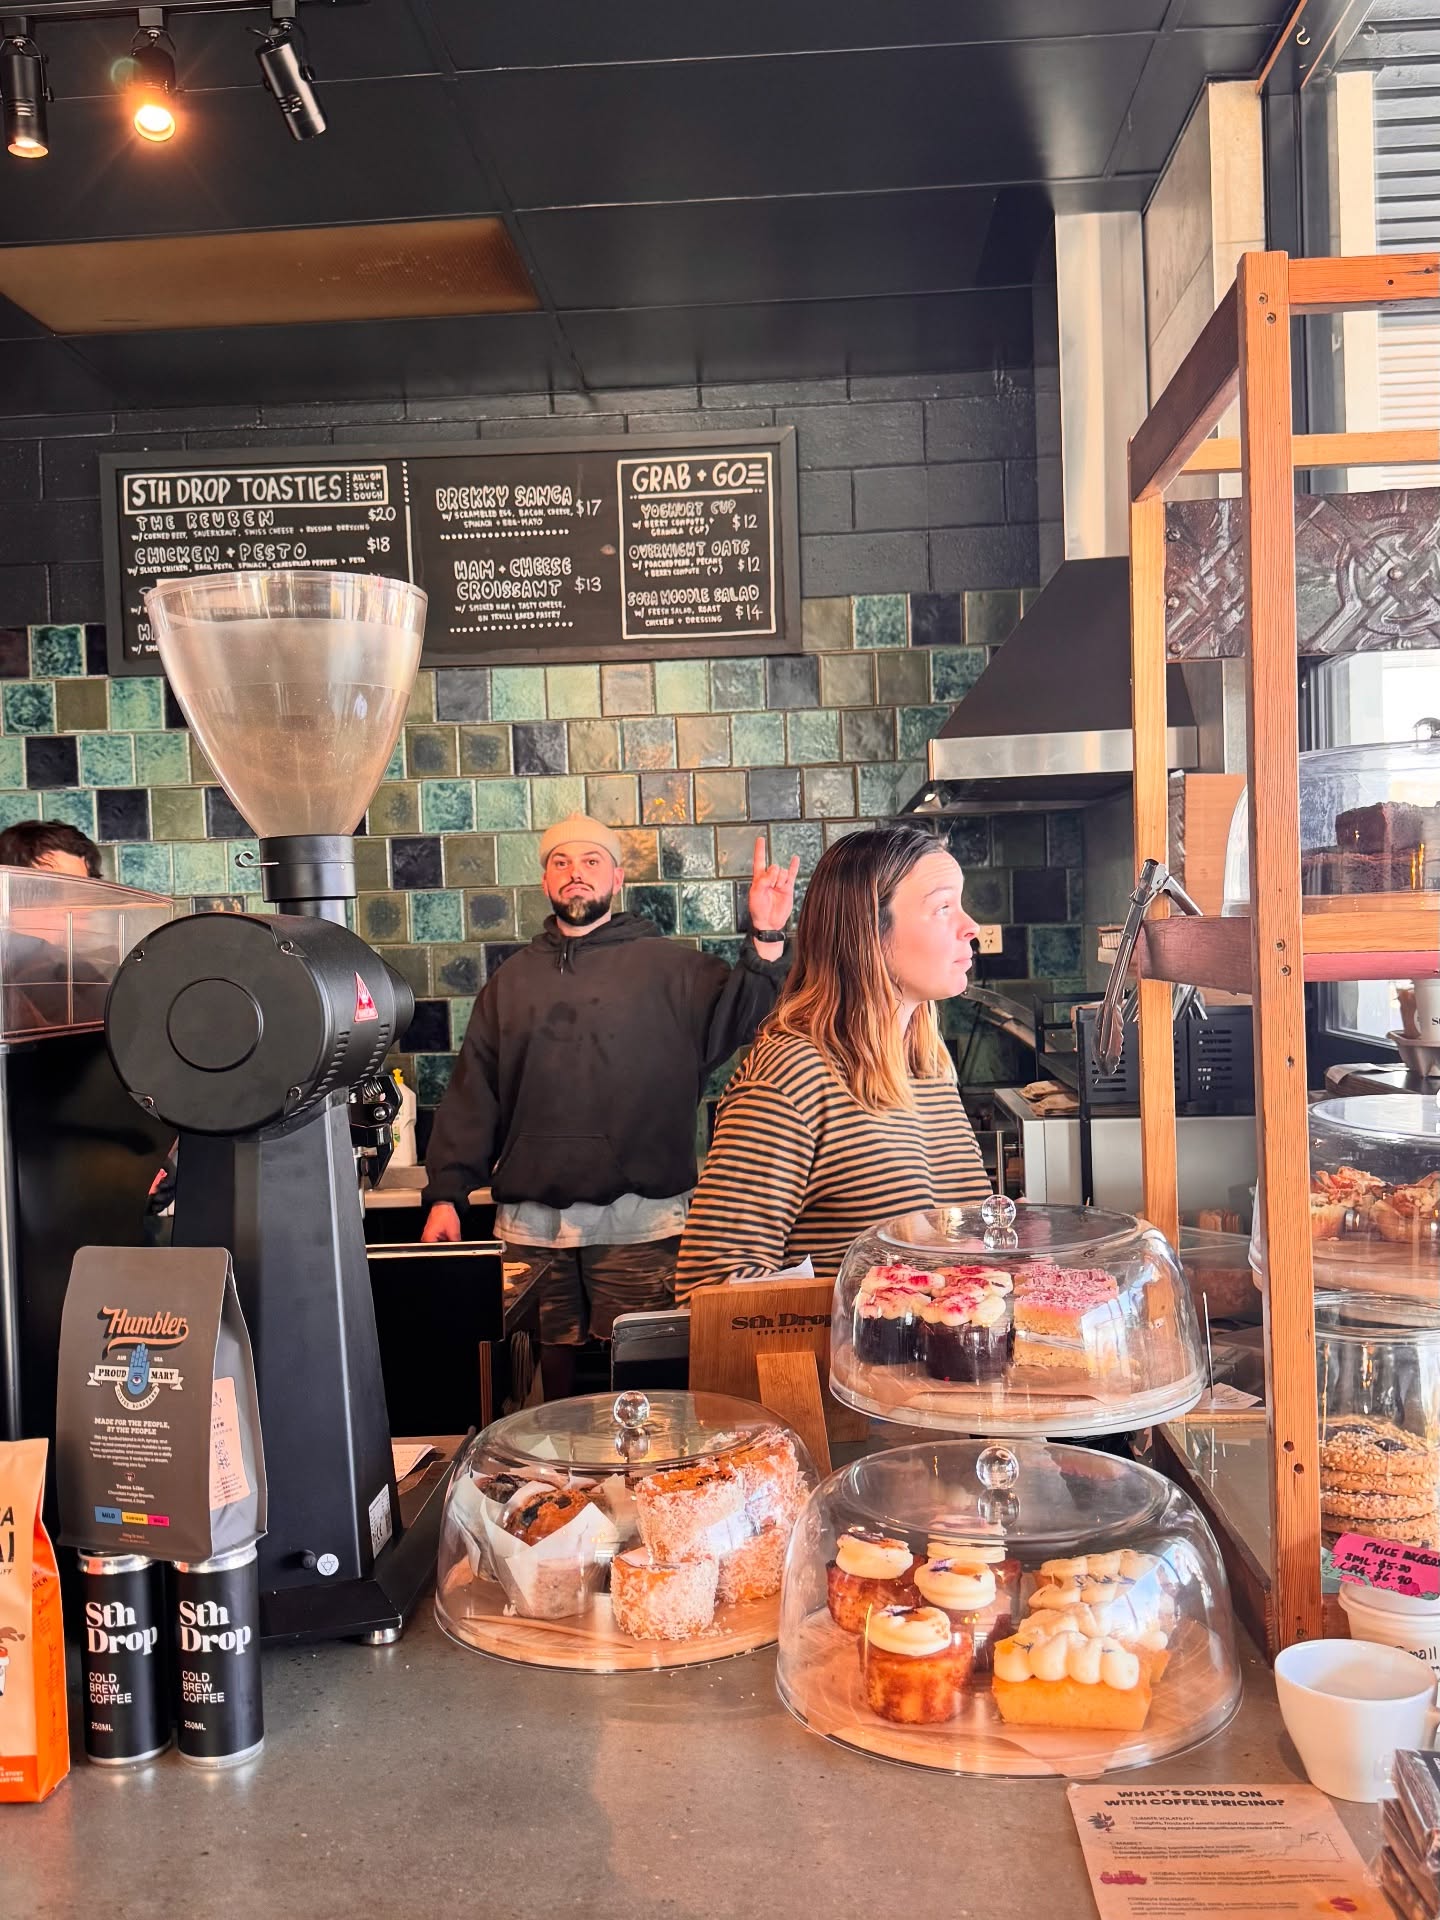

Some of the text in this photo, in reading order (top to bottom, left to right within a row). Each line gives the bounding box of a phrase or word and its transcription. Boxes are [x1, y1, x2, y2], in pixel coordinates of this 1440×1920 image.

[632, 462, 691, 493] GRAB
[132, 474, 342, 507] STH DROP TOASTIES
[353, 490, 383, 501] DOUGH
[436, 485, 573, 511] BREKKY SANGA
[368, 506, 396, 522] $20
[454, 509, 497, 520] SCRAMBLED
[575, 499, 602, 518] $17
[640, 499, 737, 520] YOGHURT CUP
[136, 509, 274, 531] THE REUBEN
[643, 518, 669, 529] BERRY
[732, 514, 758, 532] $12
[143, 532, 171, 541] CORNED
[244, 528, 267, 536] SWISS
[268, 526, 294, 535] CHEESE
[306, 525, 333, 533] RUSSIAN
[336, 523, 371, 532] DRESSING
[650, 527, 684, 537] GRANOLA
[367, 536, 391, 554] $18
[629, 539, 751, 560] OVERNIGHT OATS
[135, 545, 219, 565] CHICKEN
[239, 542, 307, 562] PESTO
[348, 556, 366, 565] FETA
[454, 559, 495, 580] HAM
[509, 556, 572, 577] CHEESE
[696, 557, 723, 566] PECANS
[738, 556, 760, 573] $12
[650, 568, 672, 578] BERRY
[456, 579, 562, 601] CROISSANT
[574, 575, 602, 594] $13
[627, 584, 760, 607] SOBA NOODLE SALAD
[468, 603, 494, 612] SMOKED
[495, 602, 511, 610] HAM
[517, 601, 537, 610] TASTY
[647, 607, 670, 616] FRESH
[697, 604, 721, 613] ROAST
[735, 604, 763, 621] $14
[478, 613, 489, 622] ON
[515, 611, 535, 620] BAKED
[536, 610, 561, 620] PASTRY
[645, 617, 674, 627] CHICKEN
[685, 615, 723, 624] DRESSING
[102, 1306, 189, 1344] Humbler
[731, 1314, 774, 1330] Sth
[757, 1326, 813, 1336] ESPRESSO
[98, 1368, 175, 1380] PROUD MARY
[94, 1417, 170, 1430] MADE FOR THE PEOPLE,
[106, 1425, 157, 1435] BY THE PEOPLE
[0, 1506, 15, 1527] A
[1363, 1542, 1400, 1557] PRICE
[86, 1601, 137, 1628] Sth
[179, 1600, 231, 1627] Sth
[87, 1626, 158, 1656] Drop
[180, 1625, 251, 1656] Drop
[89, 1672, 117, 1683] COLD
[182, 1670, 210, 1682] COLD
[89, 1682, 120, 1694] BREW
[183, 1681, 213, 1693] BREW
[90, 1692, 133, 1705] COFFEE
[183, 1691, 225, 1704] COFFEE
[91, 1721, 114, 1732] 250ML
[184, 1720, 206, 1731] 250ML
[1117, 1789, 1264, 1798] WHAT'S GOING ON
[1149, 1798, 1209, 1806] COFFEE
[1210, 1799, 1286, 1807] PRICING?
